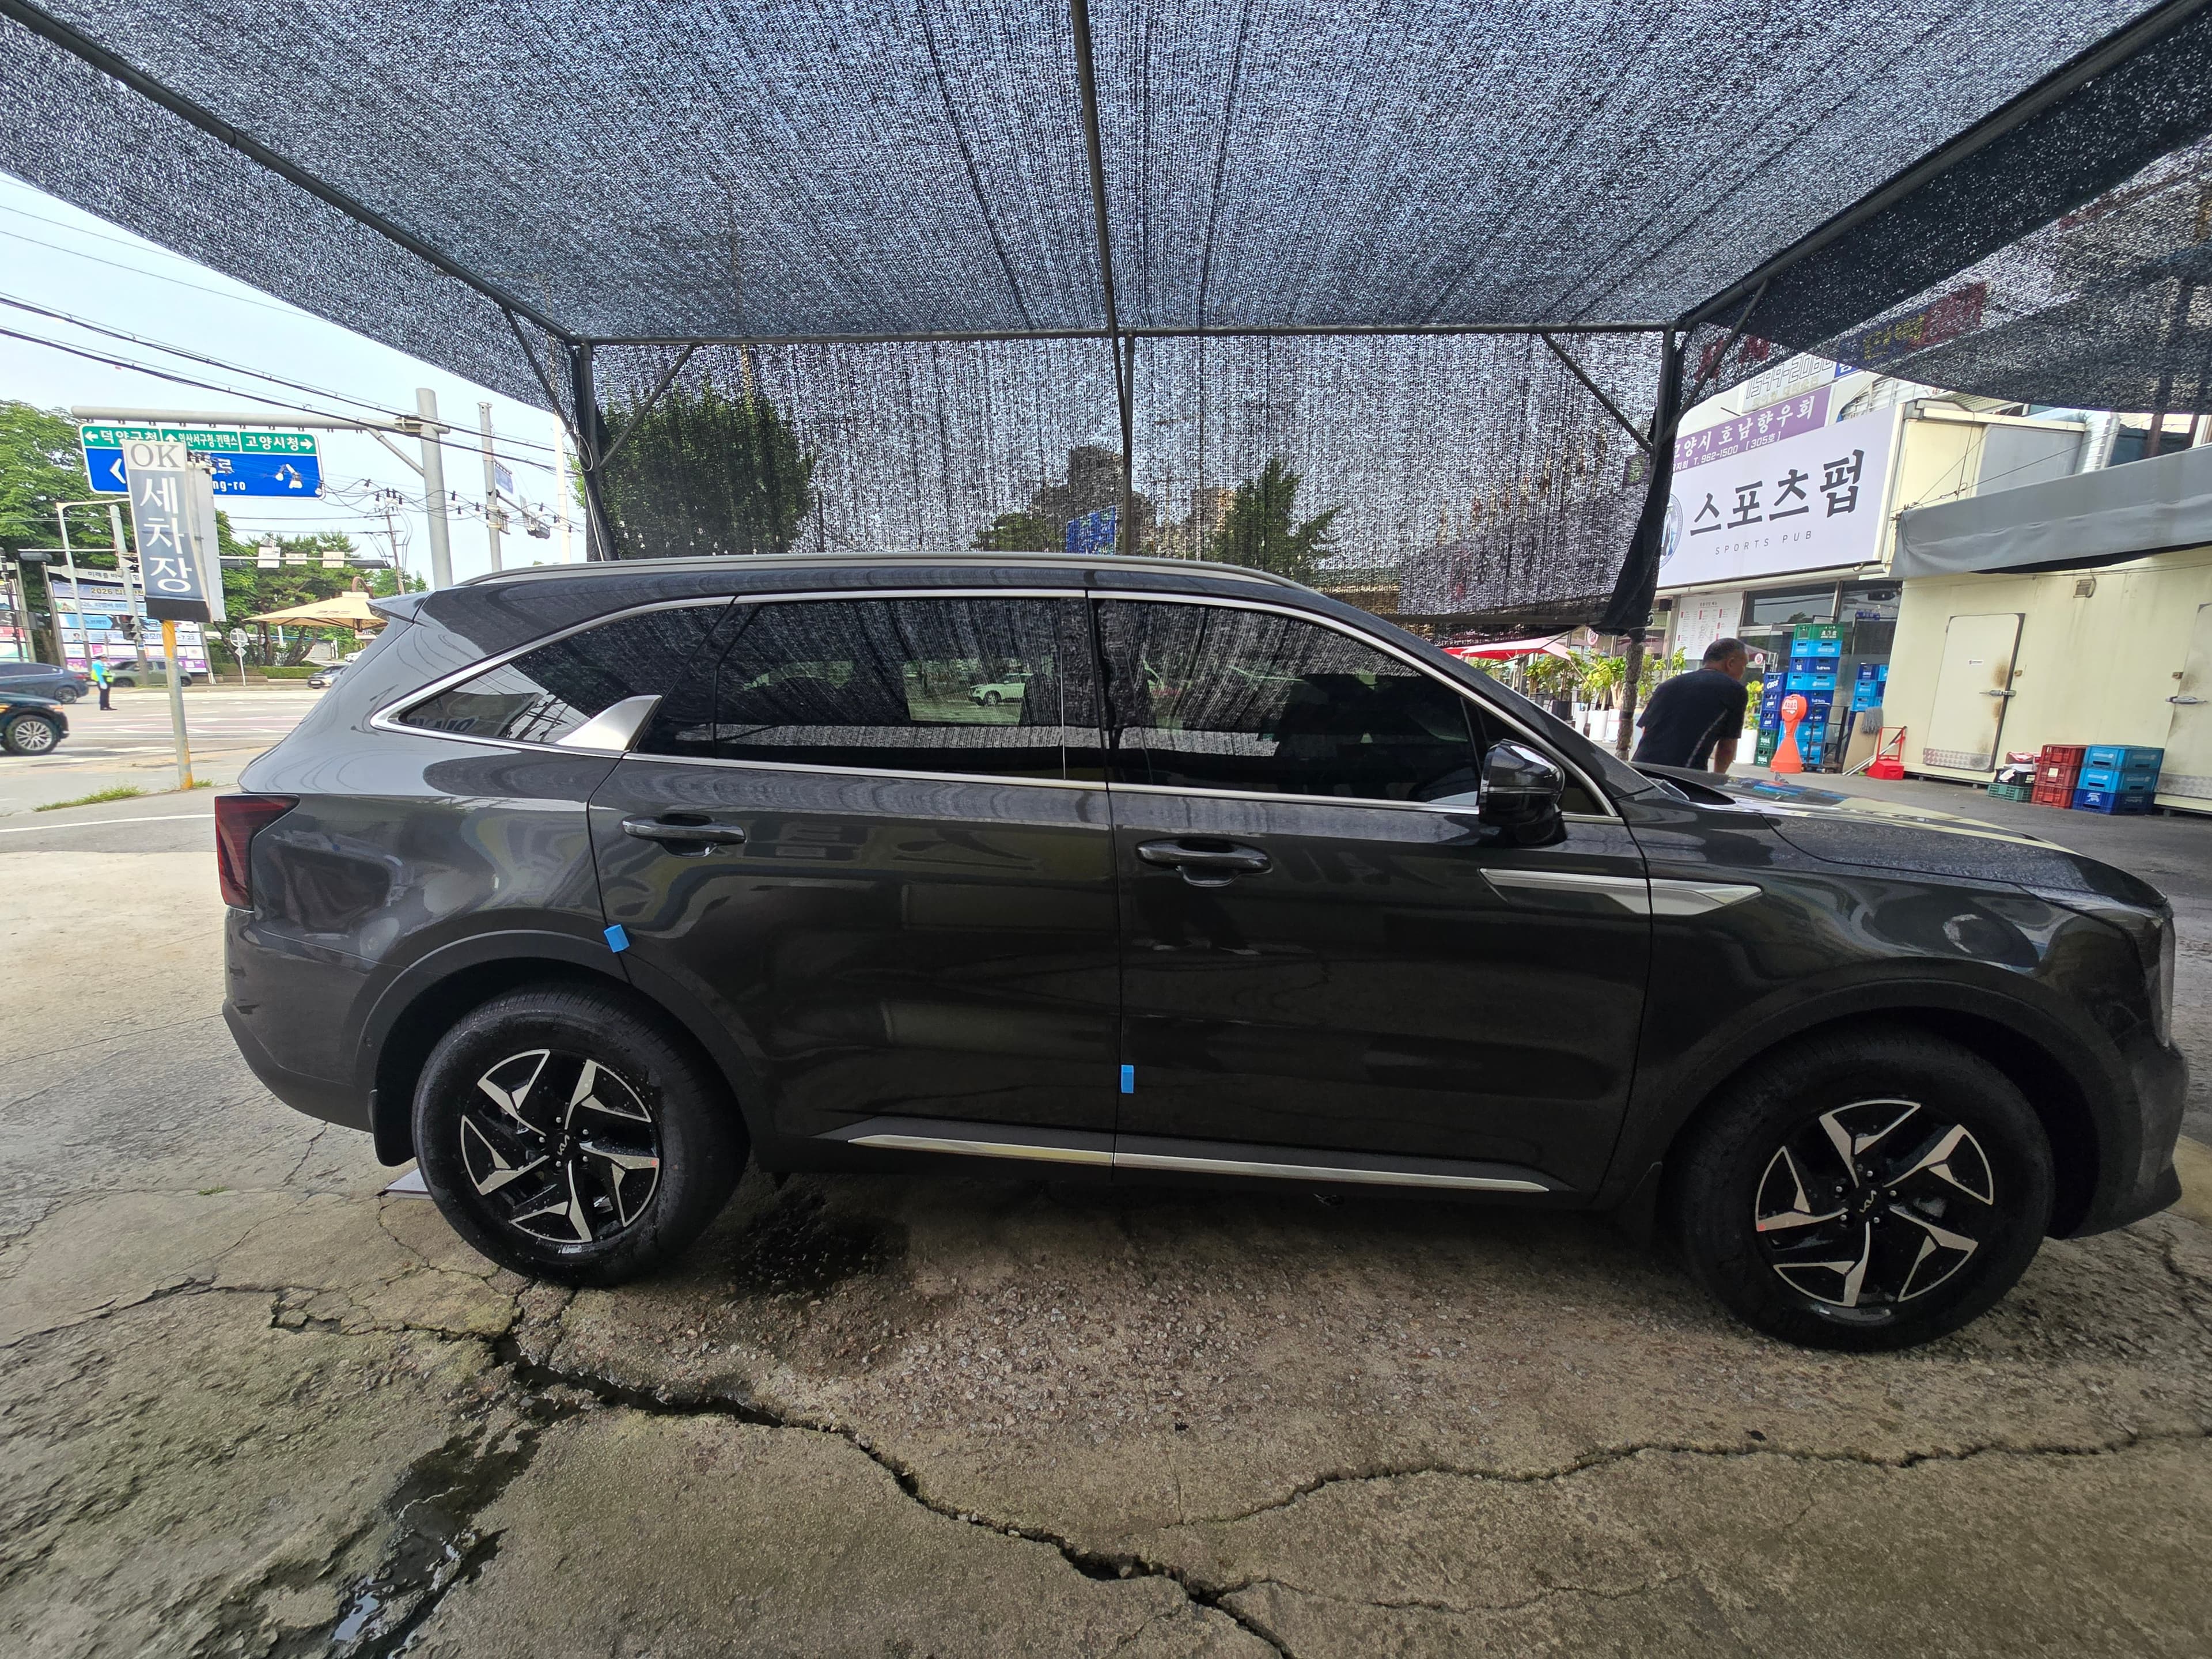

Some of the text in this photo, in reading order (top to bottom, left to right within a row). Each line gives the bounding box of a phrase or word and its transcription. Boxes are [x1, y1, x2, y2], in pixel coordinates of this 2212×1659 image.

[1718, 396, 1815, 445] 호남향우회
[130, 443, 181, 468] OK
[245, 435, 299, 450] 고양시청
[1690, 449, 1865, 536] 스포츠펍
[140, 477, 192, 593] 세차장
[1715, 531, 1812, 555] SPORTS PUB
